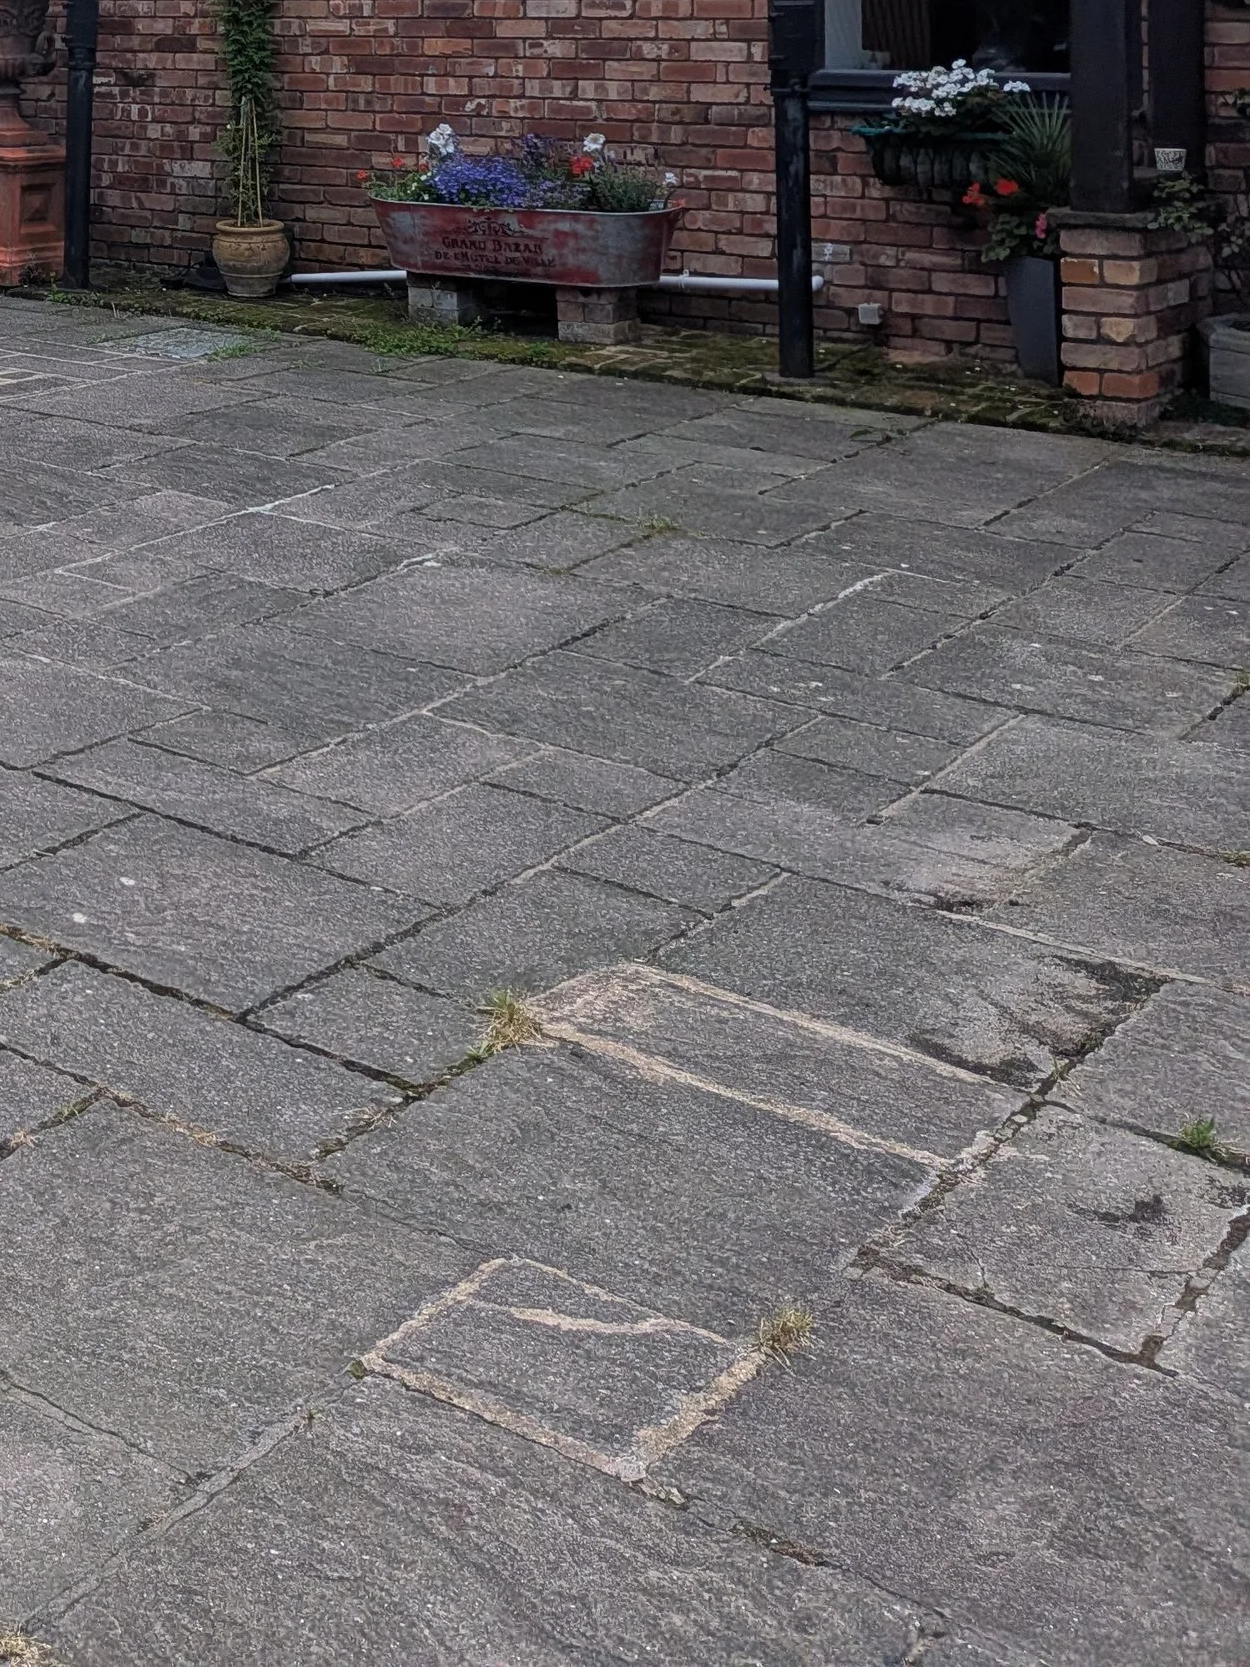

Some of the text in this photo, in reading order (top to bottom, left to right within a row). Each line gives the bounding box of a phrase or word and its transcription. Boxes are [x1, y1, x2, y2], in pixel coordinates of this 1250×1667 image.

[442, 236, 543, 254] GRAND BAZAR
[435, 250, 450, 260] DE
